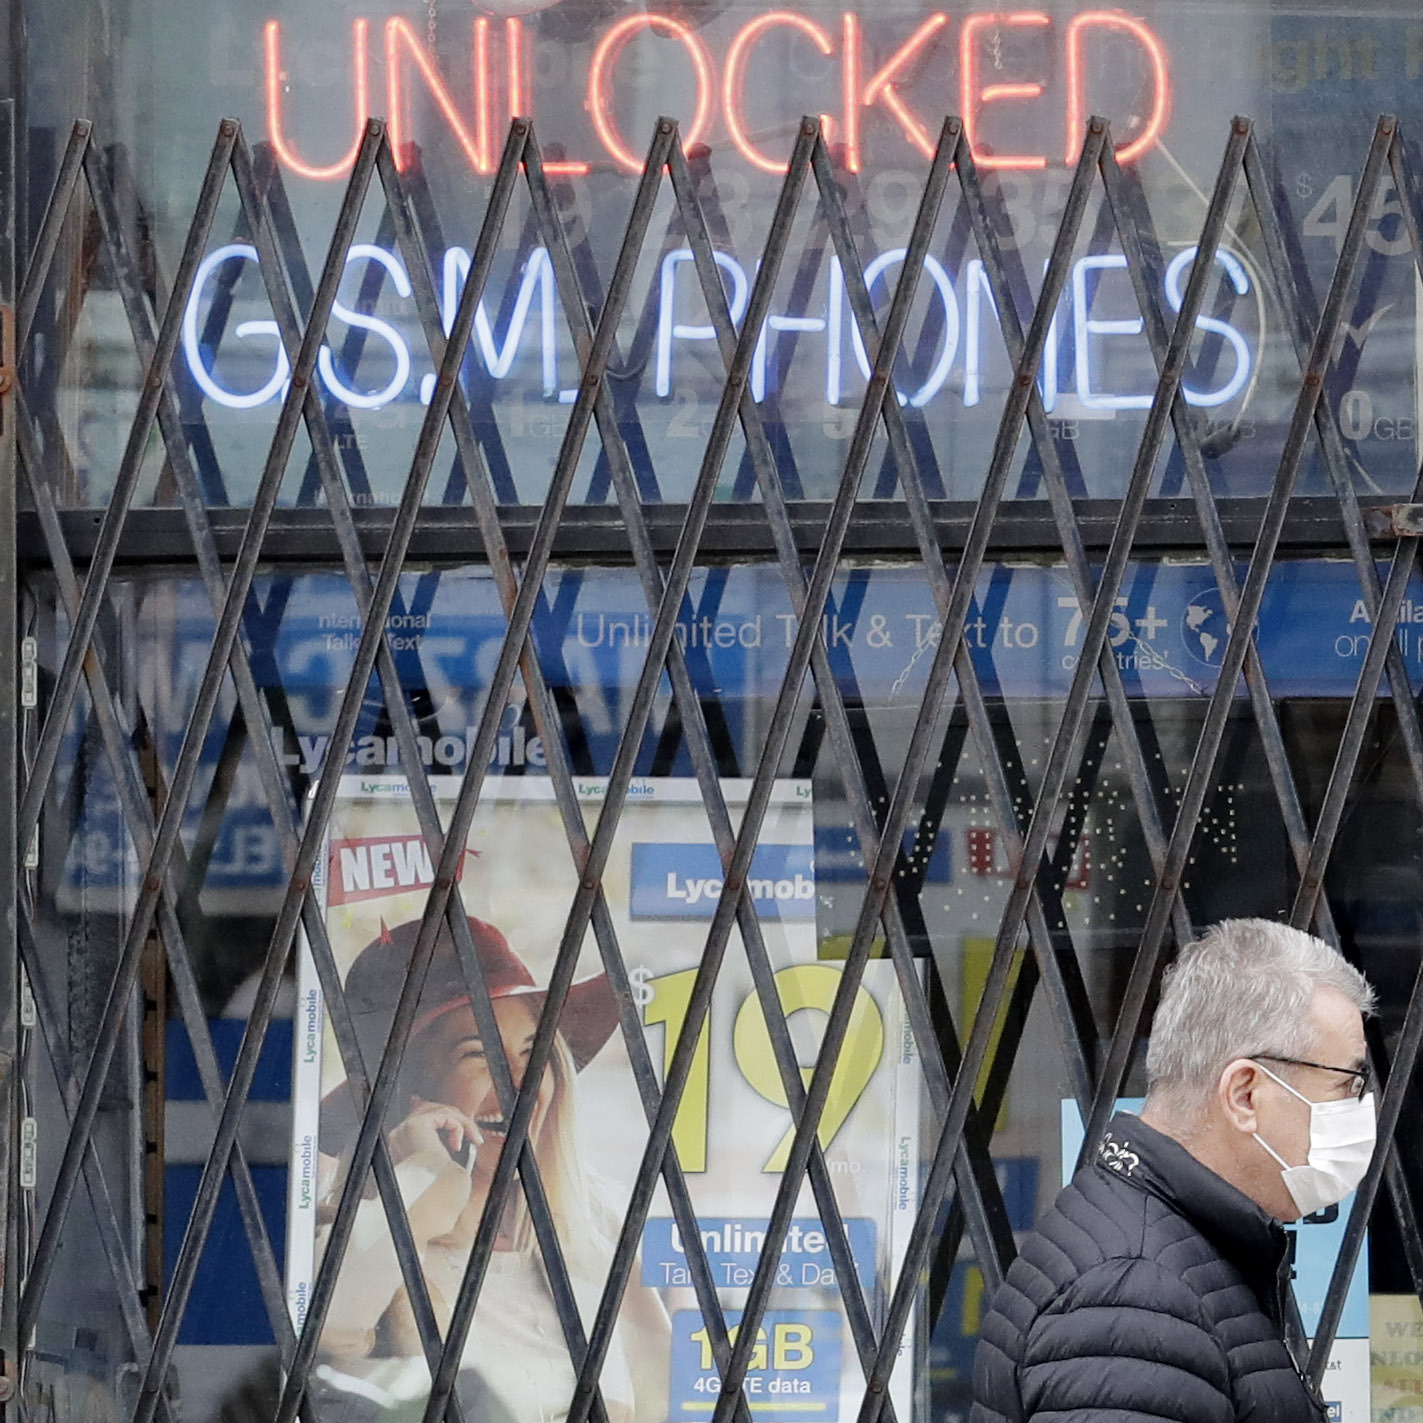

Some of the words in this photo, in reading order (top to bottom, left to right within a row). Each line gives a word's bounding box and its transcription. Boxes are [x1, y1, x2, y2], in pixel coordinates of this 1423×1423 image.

[264, 11, 1171, 180] UNLOCKED
[656, 247, 1252, 412] PHONES
[865, 616, 894, 648] &
[1003, 615, 1040, 648] to
[776, 1262, 794, 1285] &
[767, 1377, 812, 1395] data
